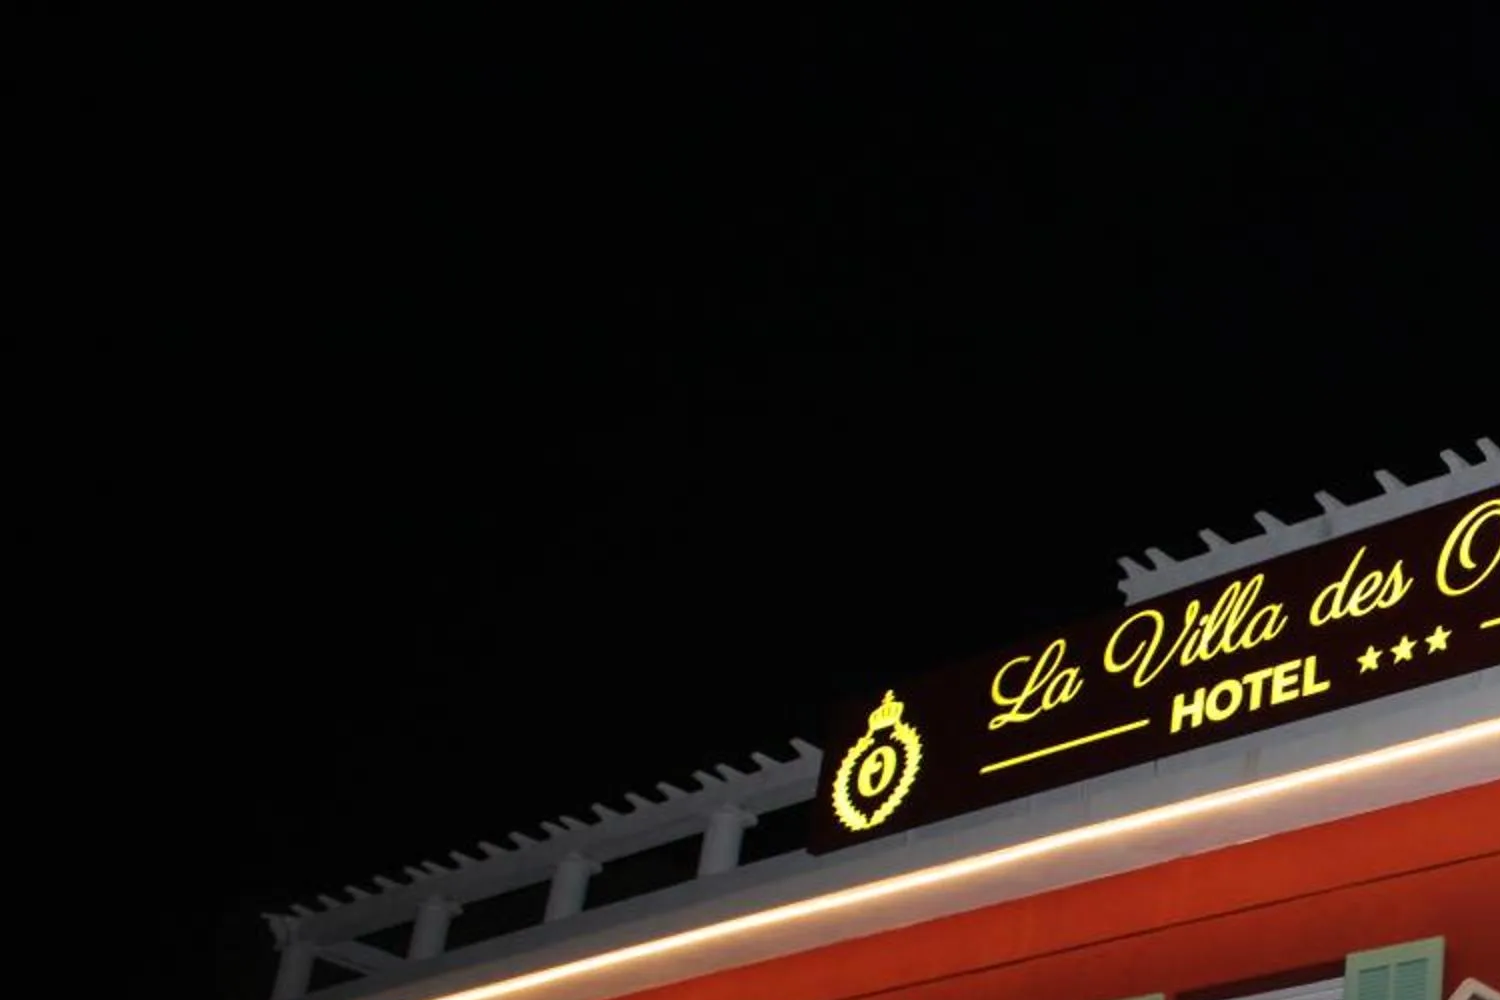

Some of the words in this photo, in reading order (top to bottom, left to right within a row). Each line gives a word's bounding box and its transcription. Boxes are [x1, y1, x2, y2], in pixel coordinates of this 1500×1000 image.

[988, 638, 1084, 731] La
[1103, 573, 1289, 689] Villa
[1309, 546, 1414, 627] des
[1170, 655, 1331, 734] HOTEL
